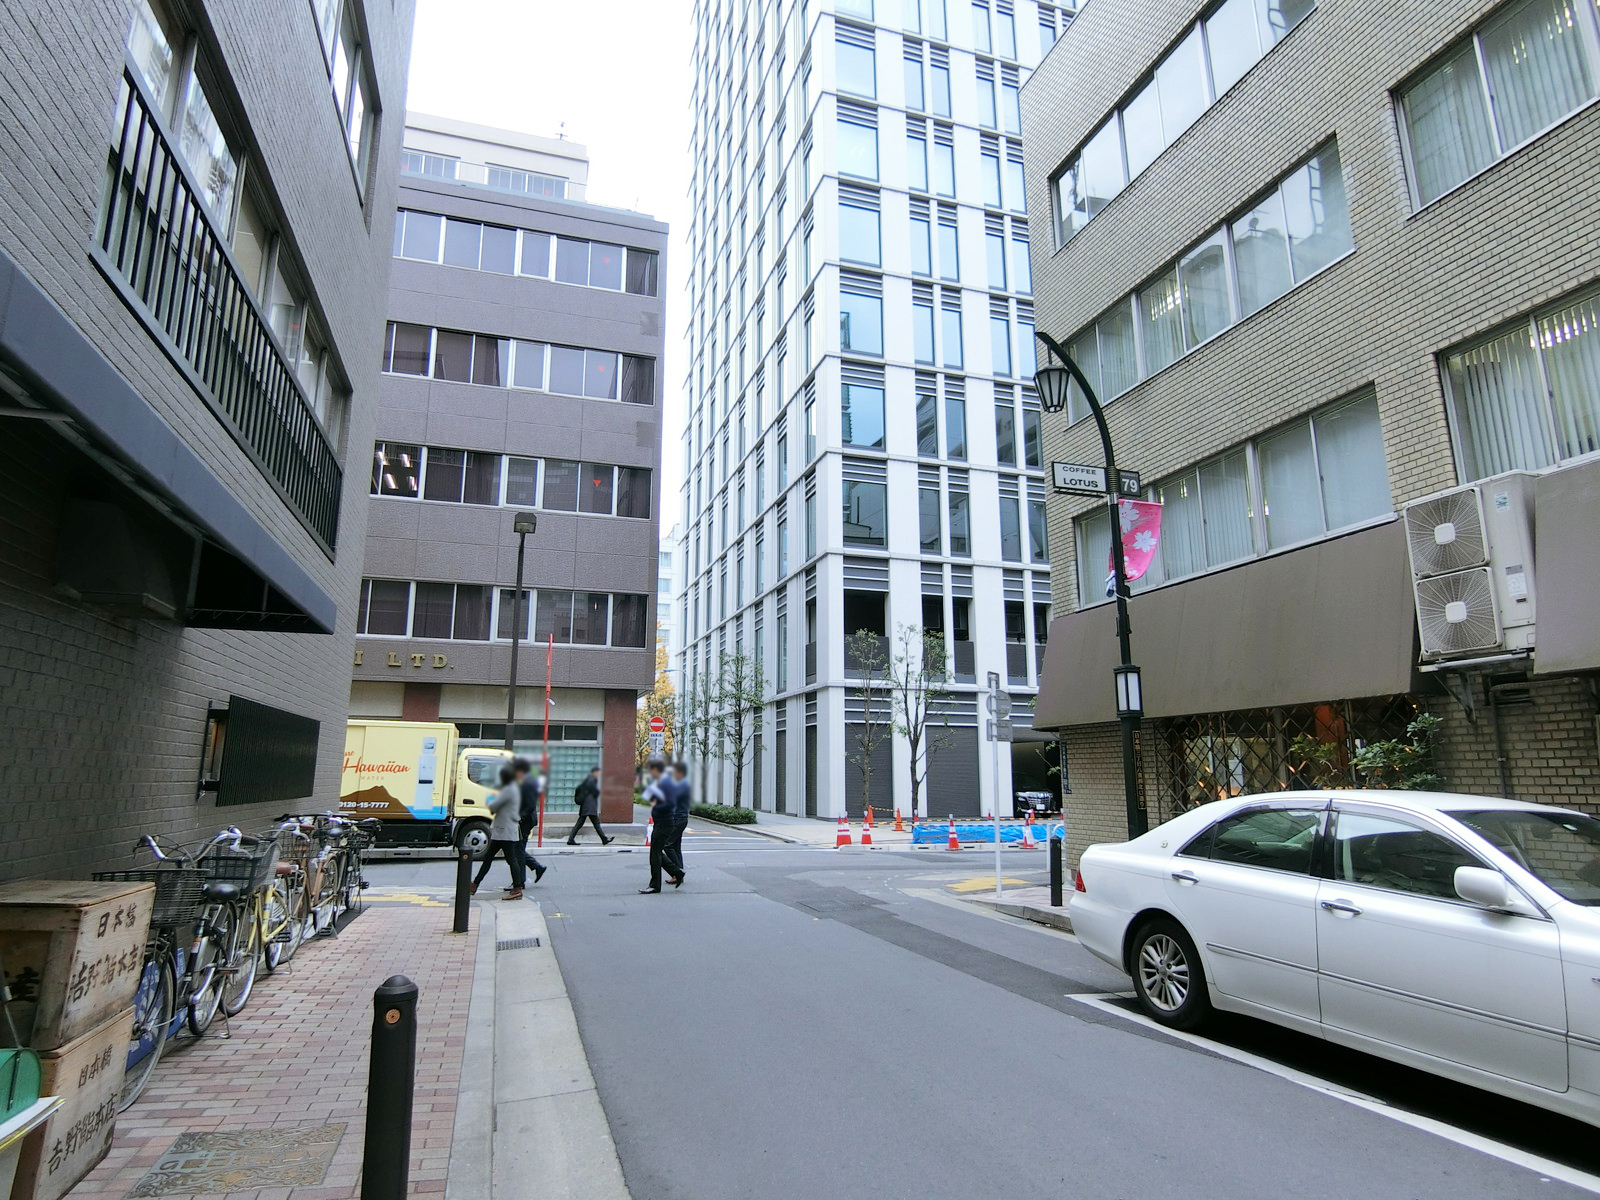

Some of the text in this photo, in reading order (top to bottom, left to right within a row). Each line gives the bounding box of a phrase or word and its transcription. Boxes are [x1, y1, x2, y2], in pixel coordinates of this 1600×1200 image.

[1062, 465, 1097, 476] COFFEE
[1063, 477, 1099, 489] LOTUS
[1121, 478, 1138, 493] 79
[387, 651, 454, 668] LTD.
[342, 756, 411, 774] Hawaiian
[78, 1043, 113, 1088] 日本橋
